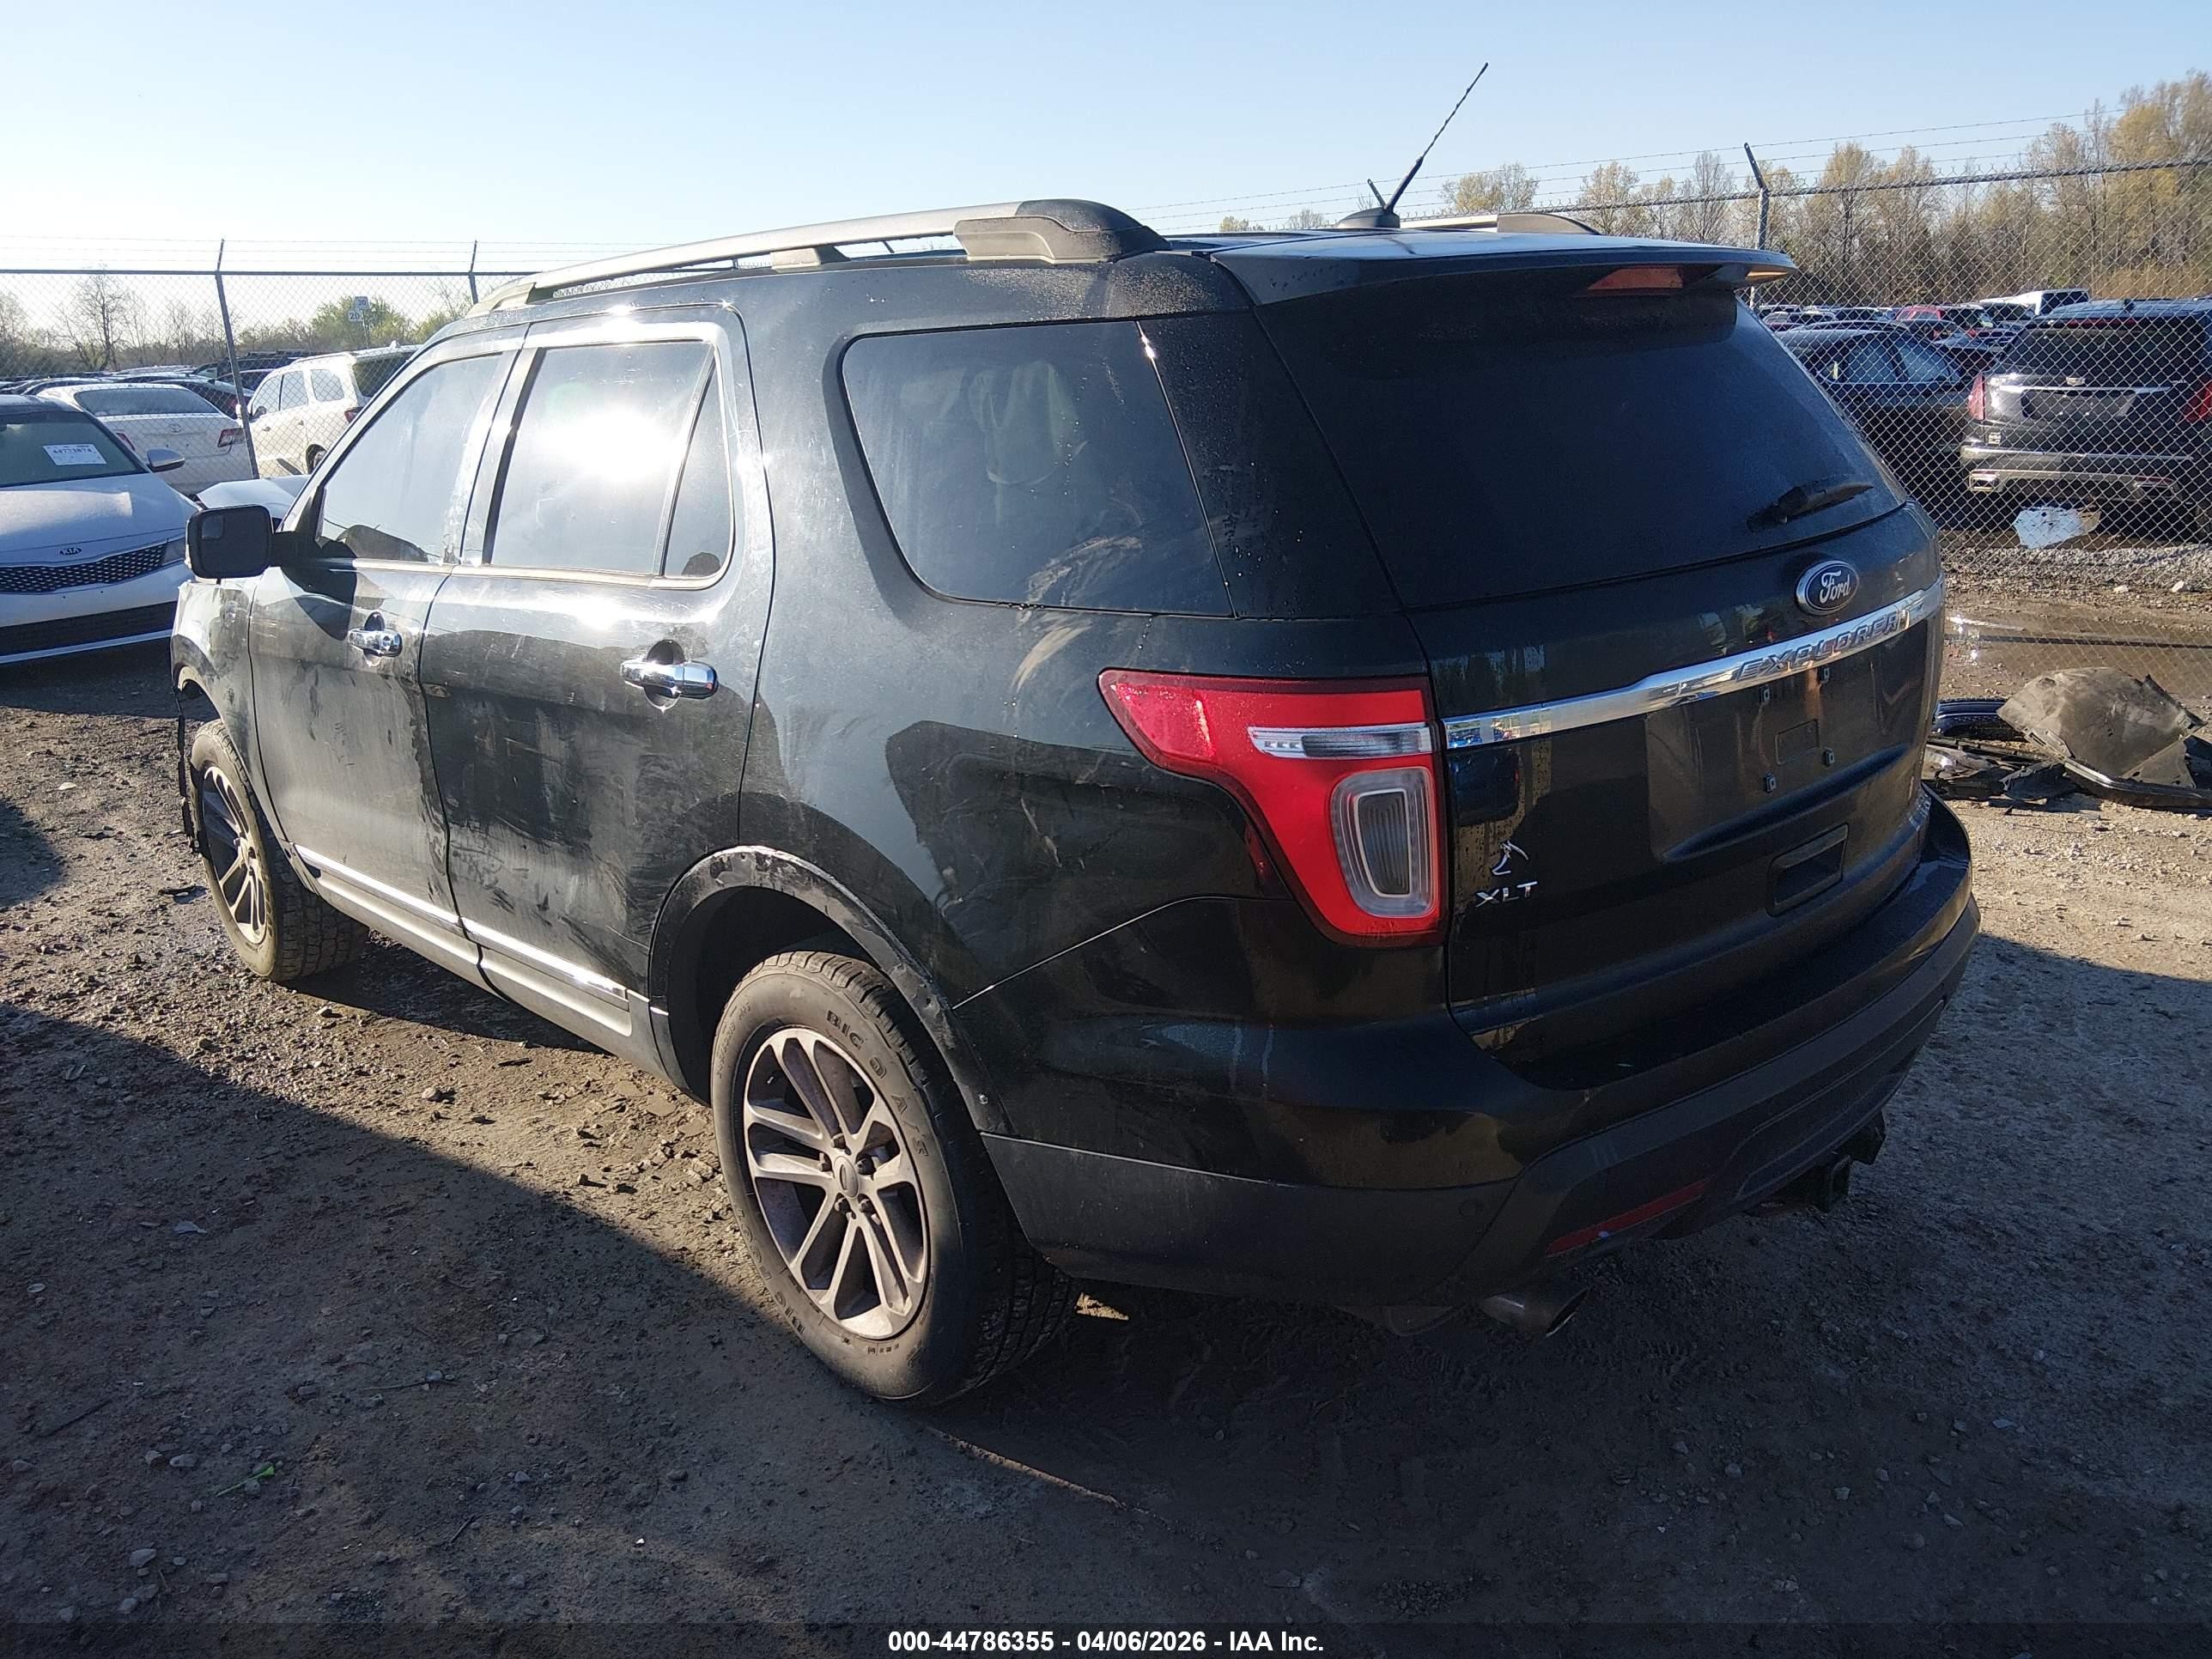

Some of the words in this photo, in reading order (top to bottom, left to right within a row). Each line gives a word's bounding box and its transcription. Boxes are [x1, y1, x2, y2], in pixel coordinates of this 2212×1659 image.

[1819, 569, 1851, 604] Ford
[1735, 610, 1901, 682] EXPLORER
[1475, 881, 1538, 908] XLT
